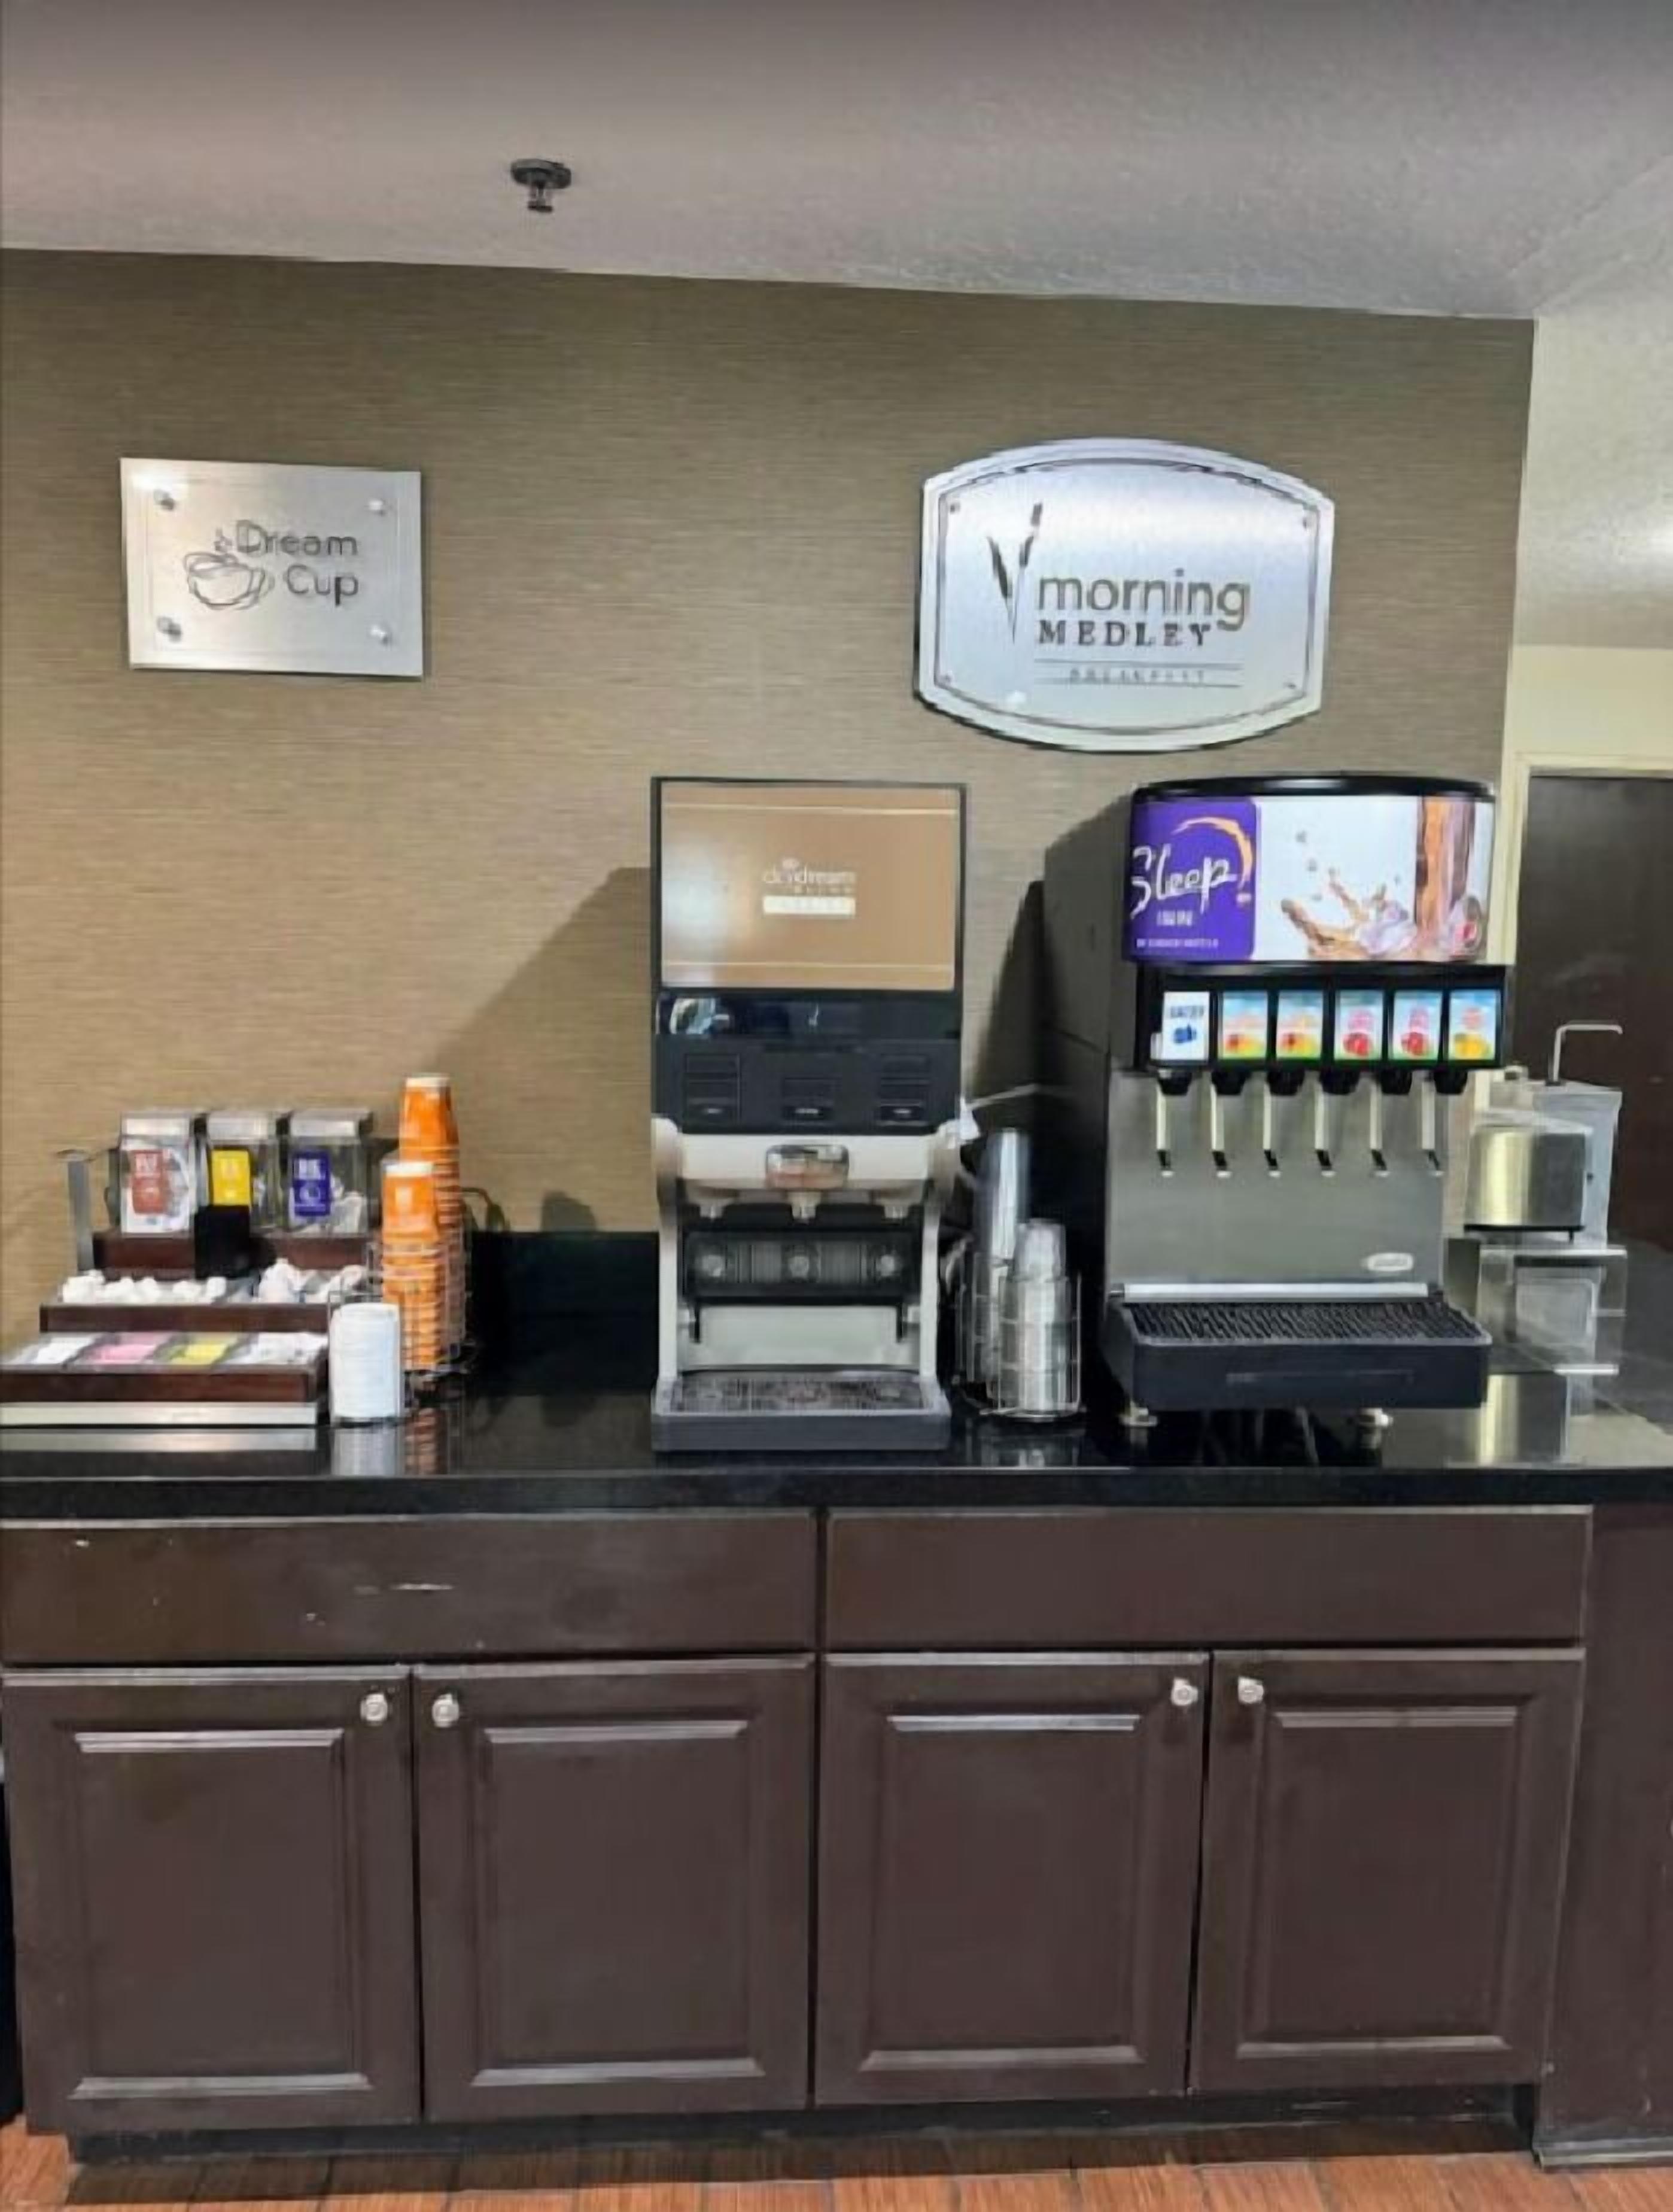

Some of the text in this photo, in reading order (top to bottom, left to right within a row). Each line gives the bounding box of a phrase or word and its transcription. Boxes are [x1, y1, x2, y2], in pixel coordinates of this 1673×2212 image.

[236, 519, 358, 556] Dream
[285, 564, 359, 606] Cup
[1038, 568, 1249, 632] morning
[1038, 619, 1211, 647] MEDLEY
[1130, 843, 1237, 919] Sleep
